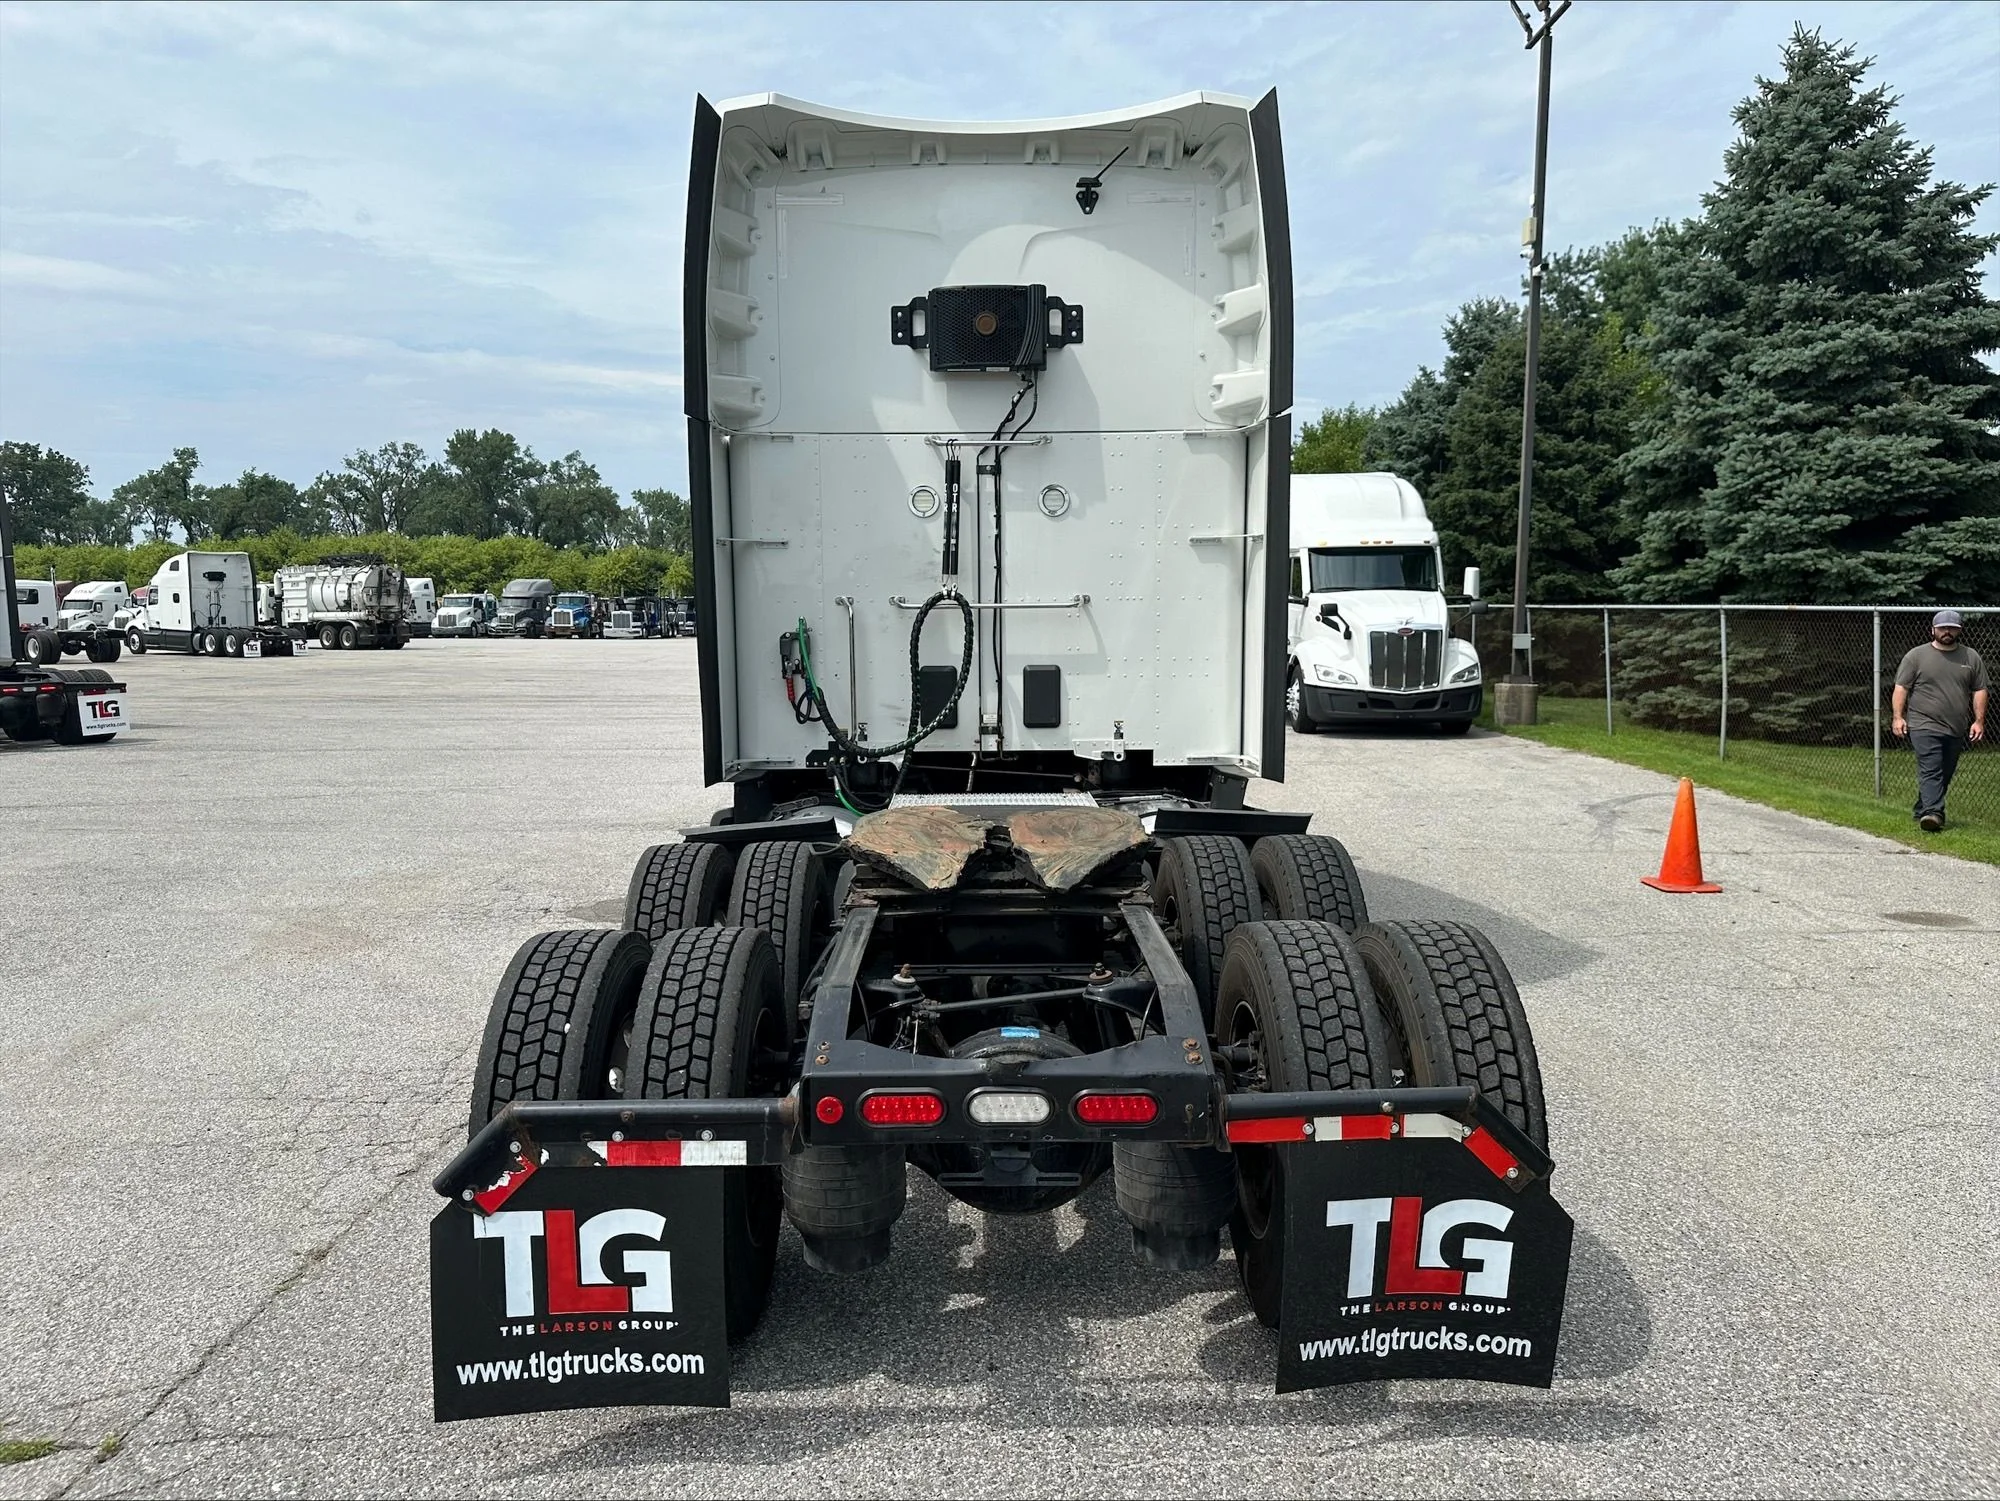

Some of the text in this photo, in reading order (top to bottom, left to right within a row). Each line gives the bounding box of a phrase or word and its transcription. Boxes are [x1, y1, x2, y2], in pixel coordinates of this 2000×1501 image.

[86, 700, 121, 719] TLG
[473, 1208, 673, 1318] TLG
[1326, 1196, 1514, 1299] TLG
[1340, 1300, 1507, 1316] THE LARSON GROUP
[500, 1320, 674, 1337] THE LARSON GROUP
[1299, 1326, 1532, 1361] www.tlgtrucks.com
[456, 1347, 705, 1385] www.tlgtrucks.com
